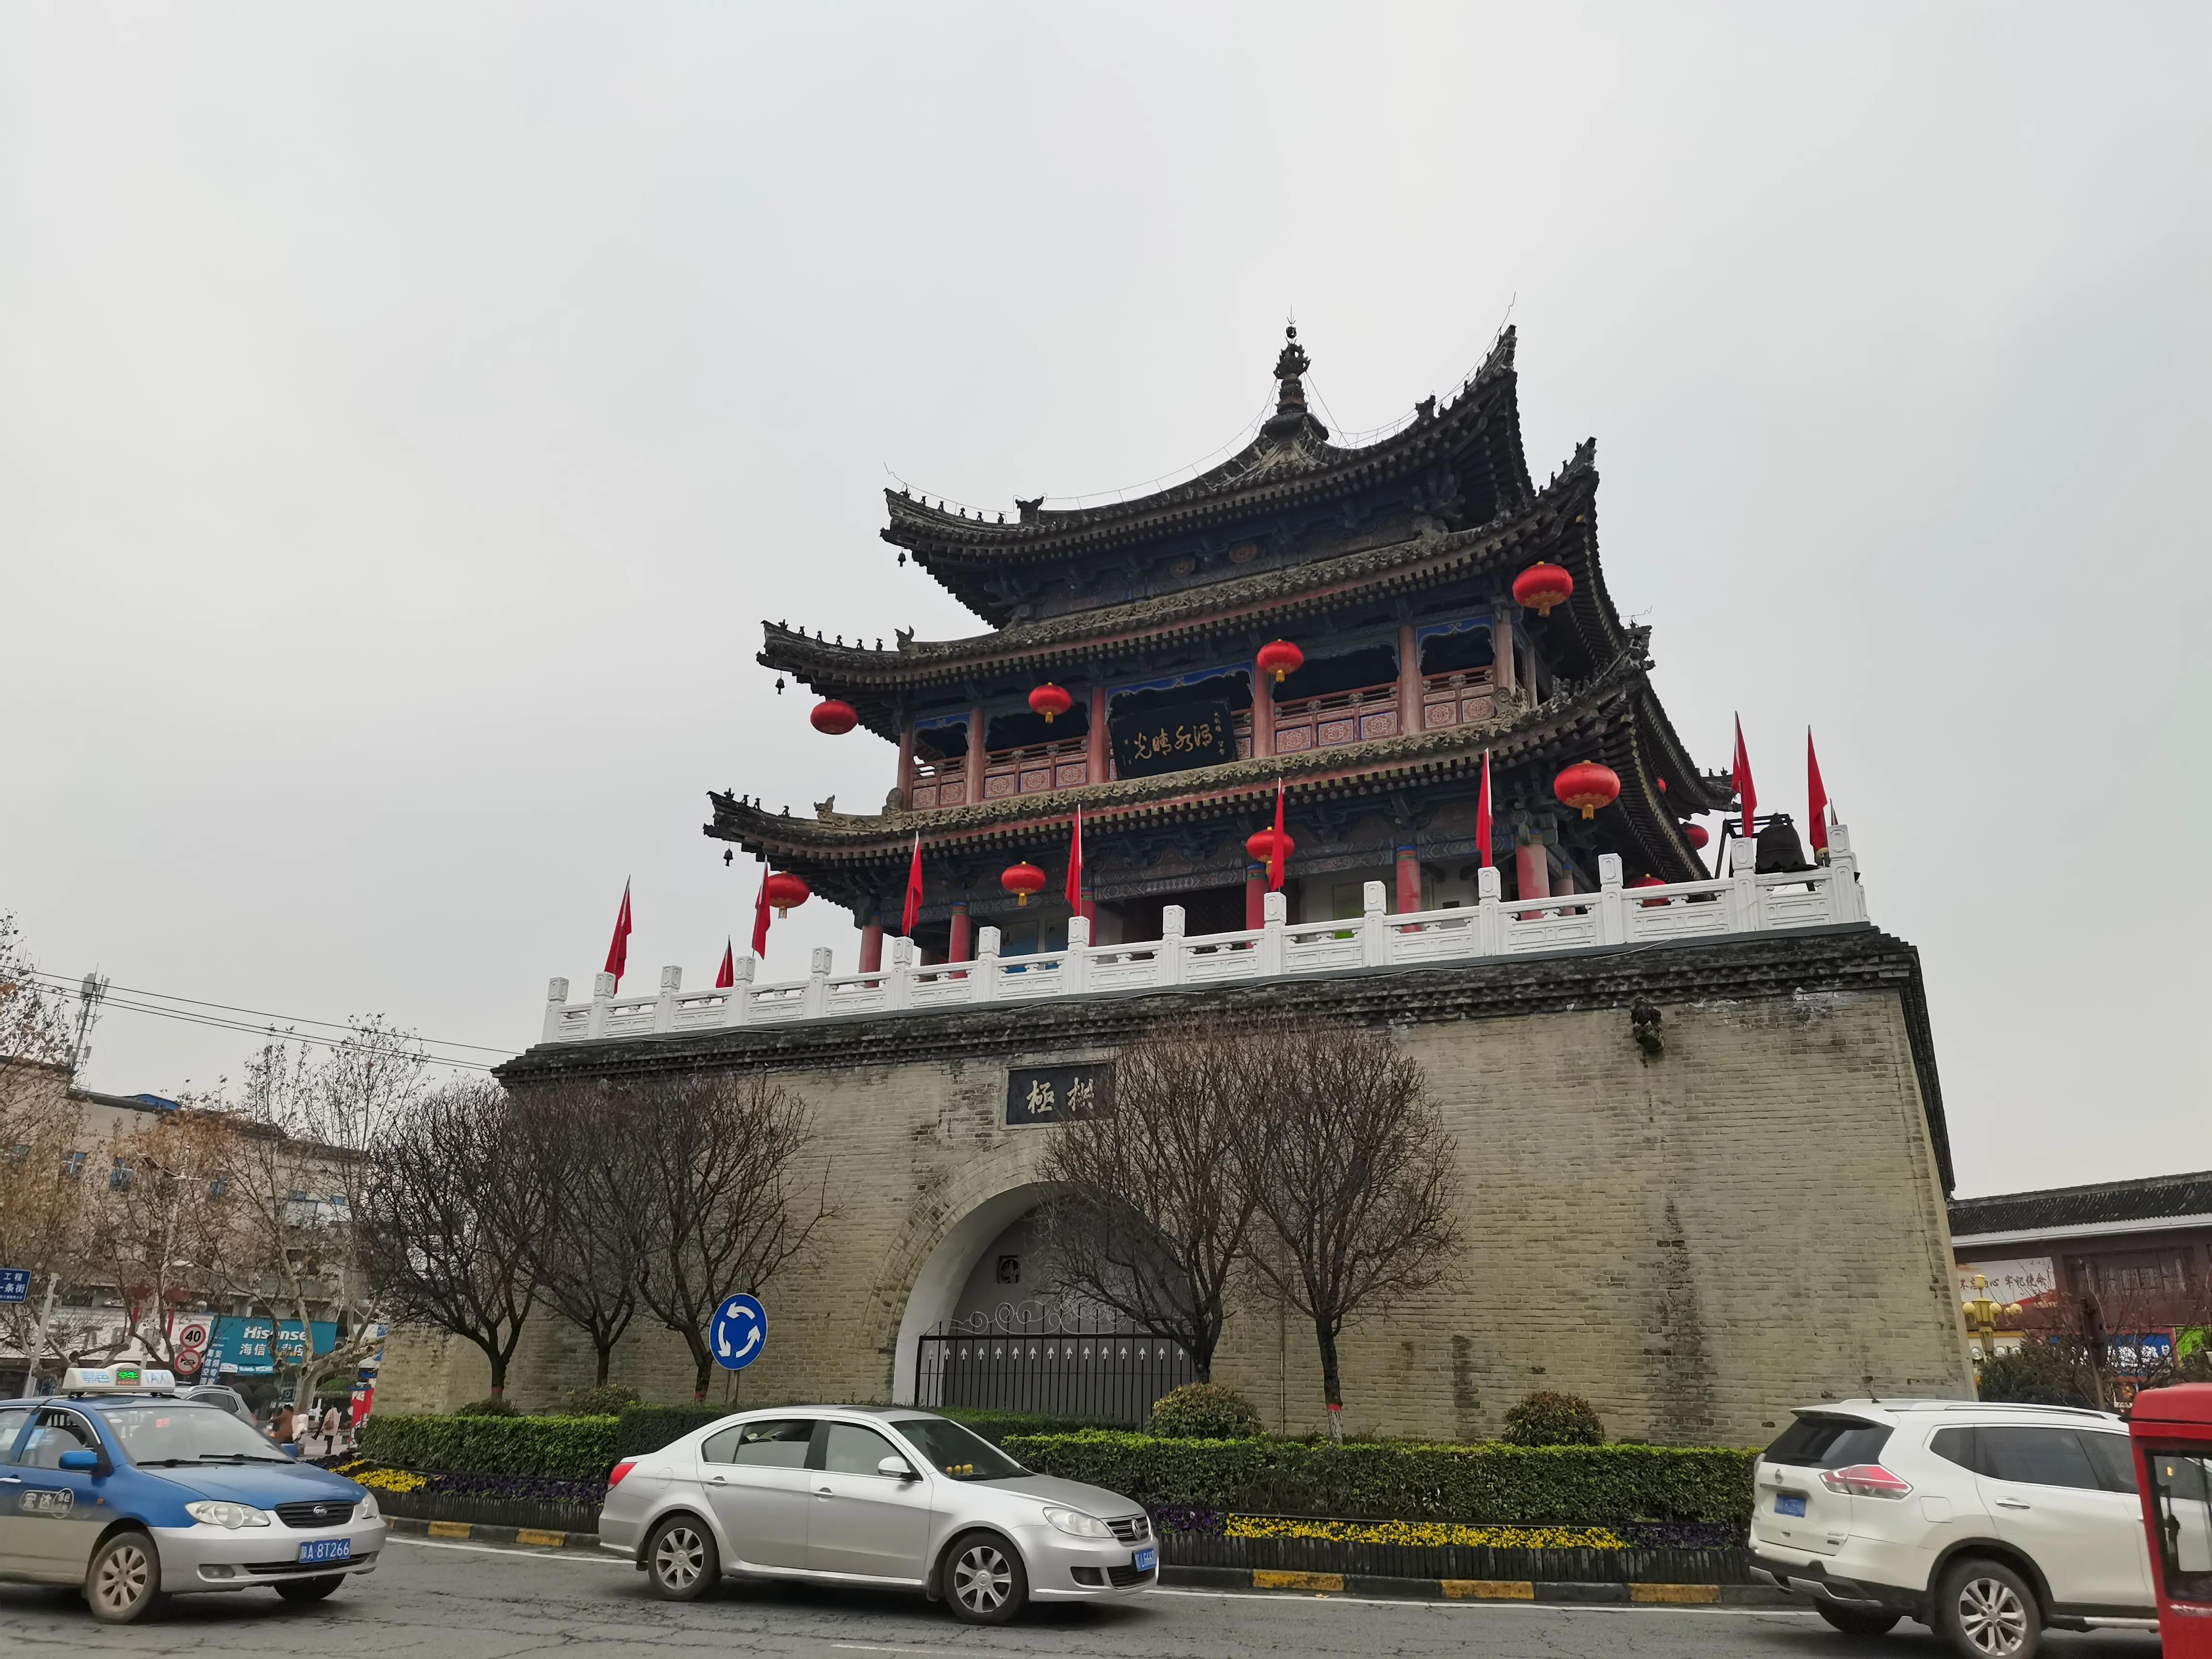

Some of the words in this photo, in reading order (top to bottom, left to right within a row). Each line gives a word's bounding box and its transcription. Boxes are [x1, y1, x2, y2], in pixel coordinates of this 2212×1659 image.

[3, 1272, 23, 1281] 工程
[185, 1330, 201, 1342] 40
[243, 1326, 306, 1341] Hisnse
